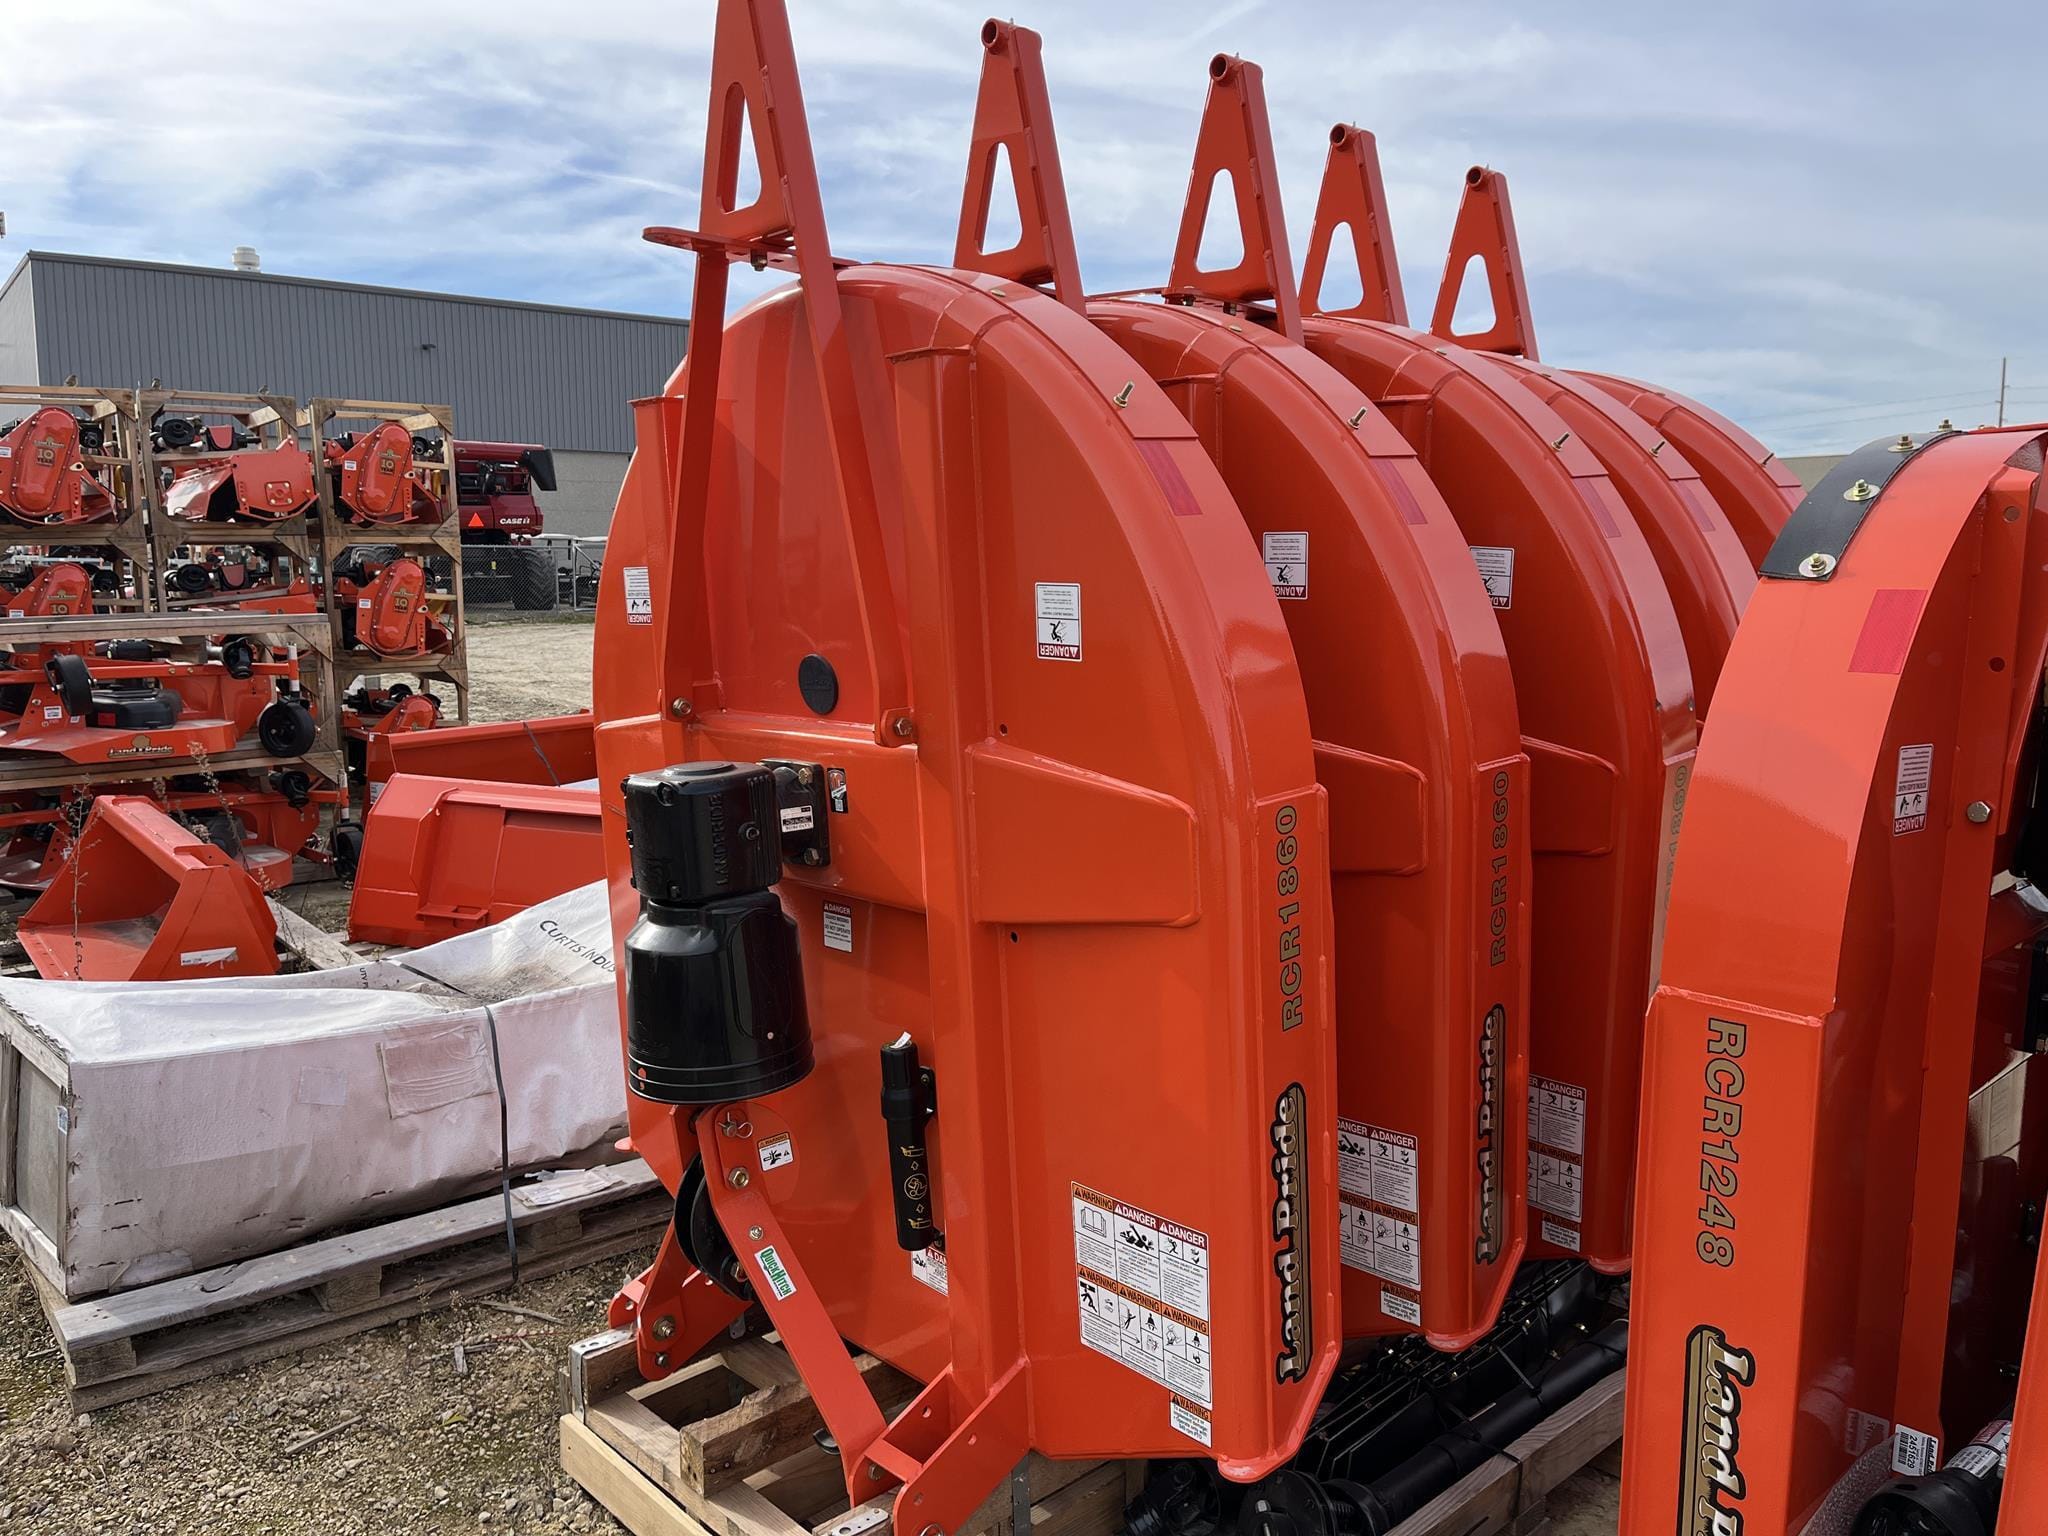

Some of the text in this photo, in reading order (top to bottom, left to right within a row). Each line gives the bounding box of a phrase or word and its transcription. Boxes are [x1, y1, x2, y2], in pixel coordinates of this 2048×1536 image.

[1273, 586, 1296, 597] DANG
[1040, 644, 1070, 657] DANGER
[1895, 815, 1919, 832] DANGER
[1490, 771, 1509, 968] RCR1860
[829, 903, 850, 915] DANGER
[1275, 805, 1303, 1032] RCR1860
[540, 920, 586, 953] CURTIS
[1549, 1083, 1583, 1098] DANGER
[1380, 1131, 1414, 1148] DANGER
[1477, 1014, 1498, 1262] Land Pride
[1696, 1017, 1747, 1268] RCR1248
[1081, 1188, 1113, 1211] WARNING
[1122, 1206, 1157, 1229] DANGER
[1381, 1205, 1416, 1223] WARNING
[1168, 1225, 1205, 1247] DANGER
[1273, 1096, 1303, 1378] Land Pride
[1086, 1269, 1117, 1291] WARNING
[1126, 1288, 1160, 1311] WARNING
[1172, 1312, 1207, 1333] WARNING
[1180, 1399, 1209, 1420] WARNING
[1701, 1336, 1749, 1494] Land
[1907, 1434, 1918, 1469] 2451629
[1928, 1437, 1937, 1459] Land
